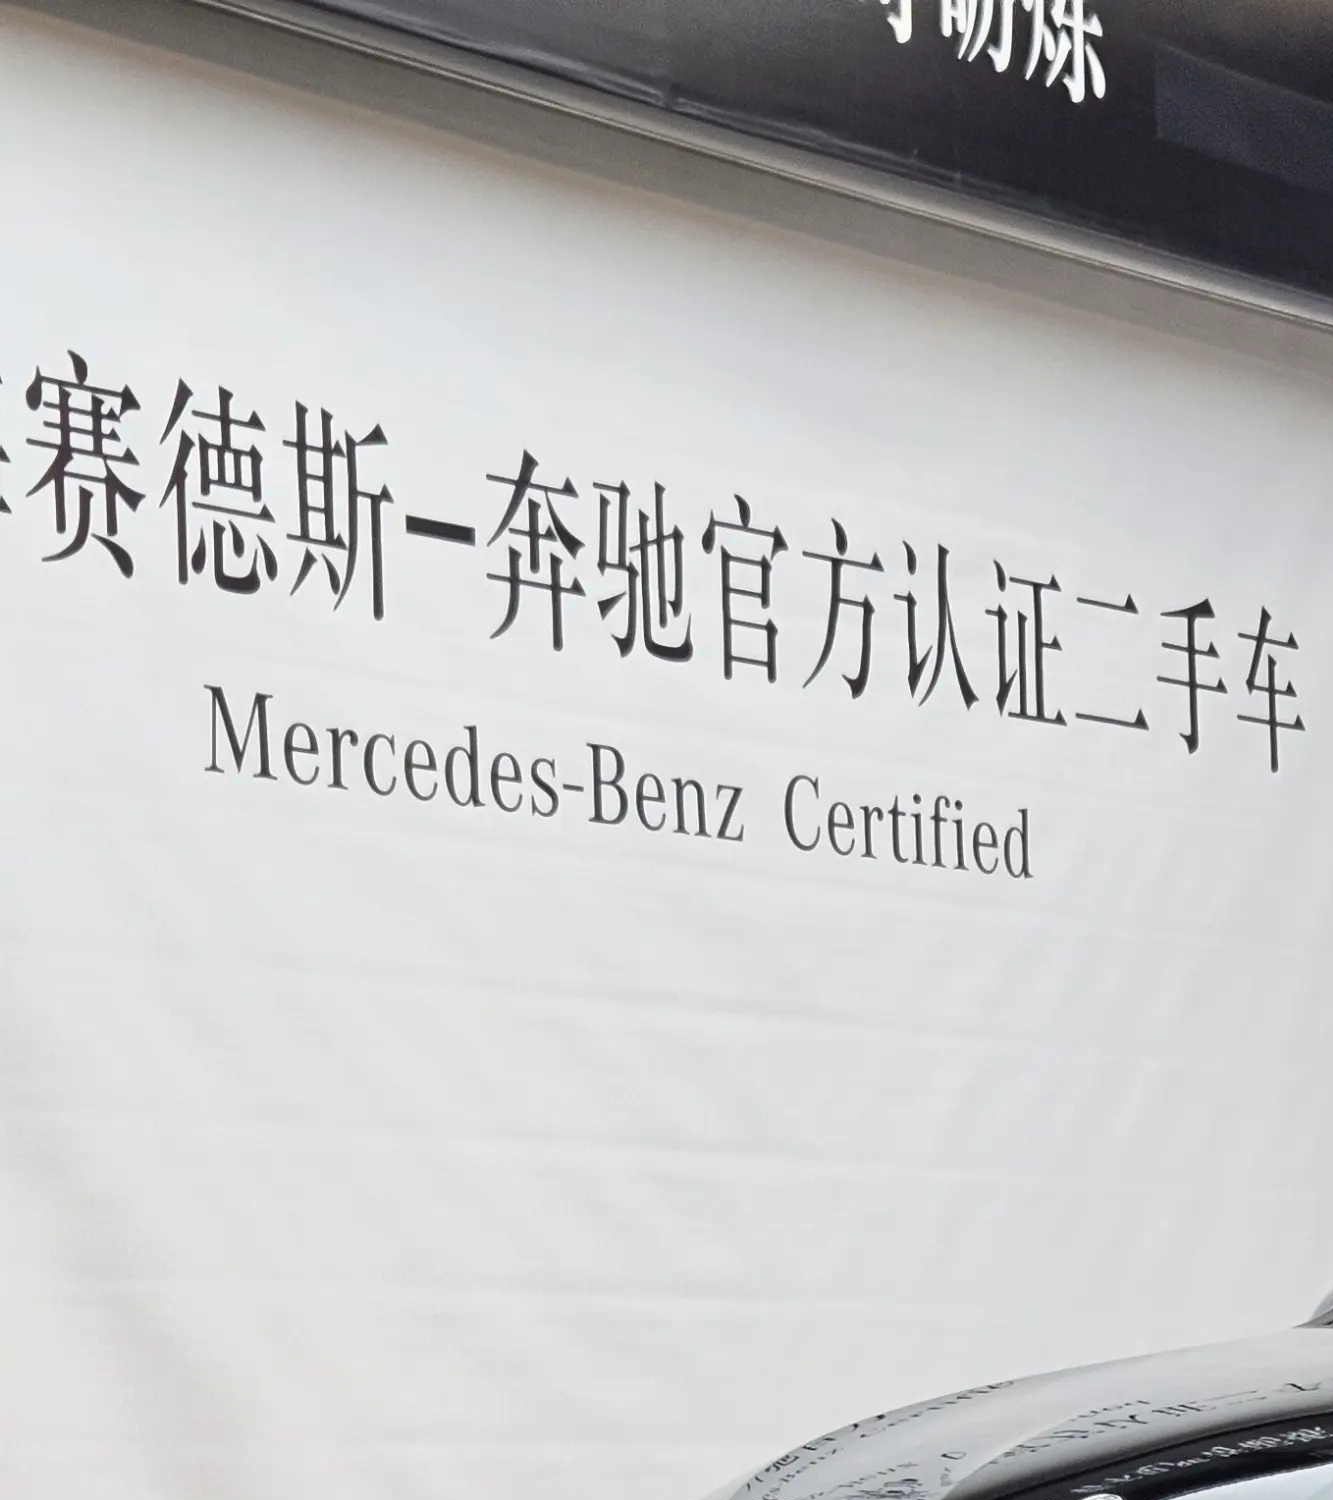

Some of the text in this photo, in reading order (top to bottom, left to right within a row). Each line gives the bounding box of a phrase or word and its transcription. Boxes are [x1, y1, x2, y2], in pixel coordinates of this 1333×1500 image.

[0, 348, 1306, 773] 赛德斯-奔驰官方认证二手车
[203, 684, 1034, 880] Mercedes-Benz Certified
